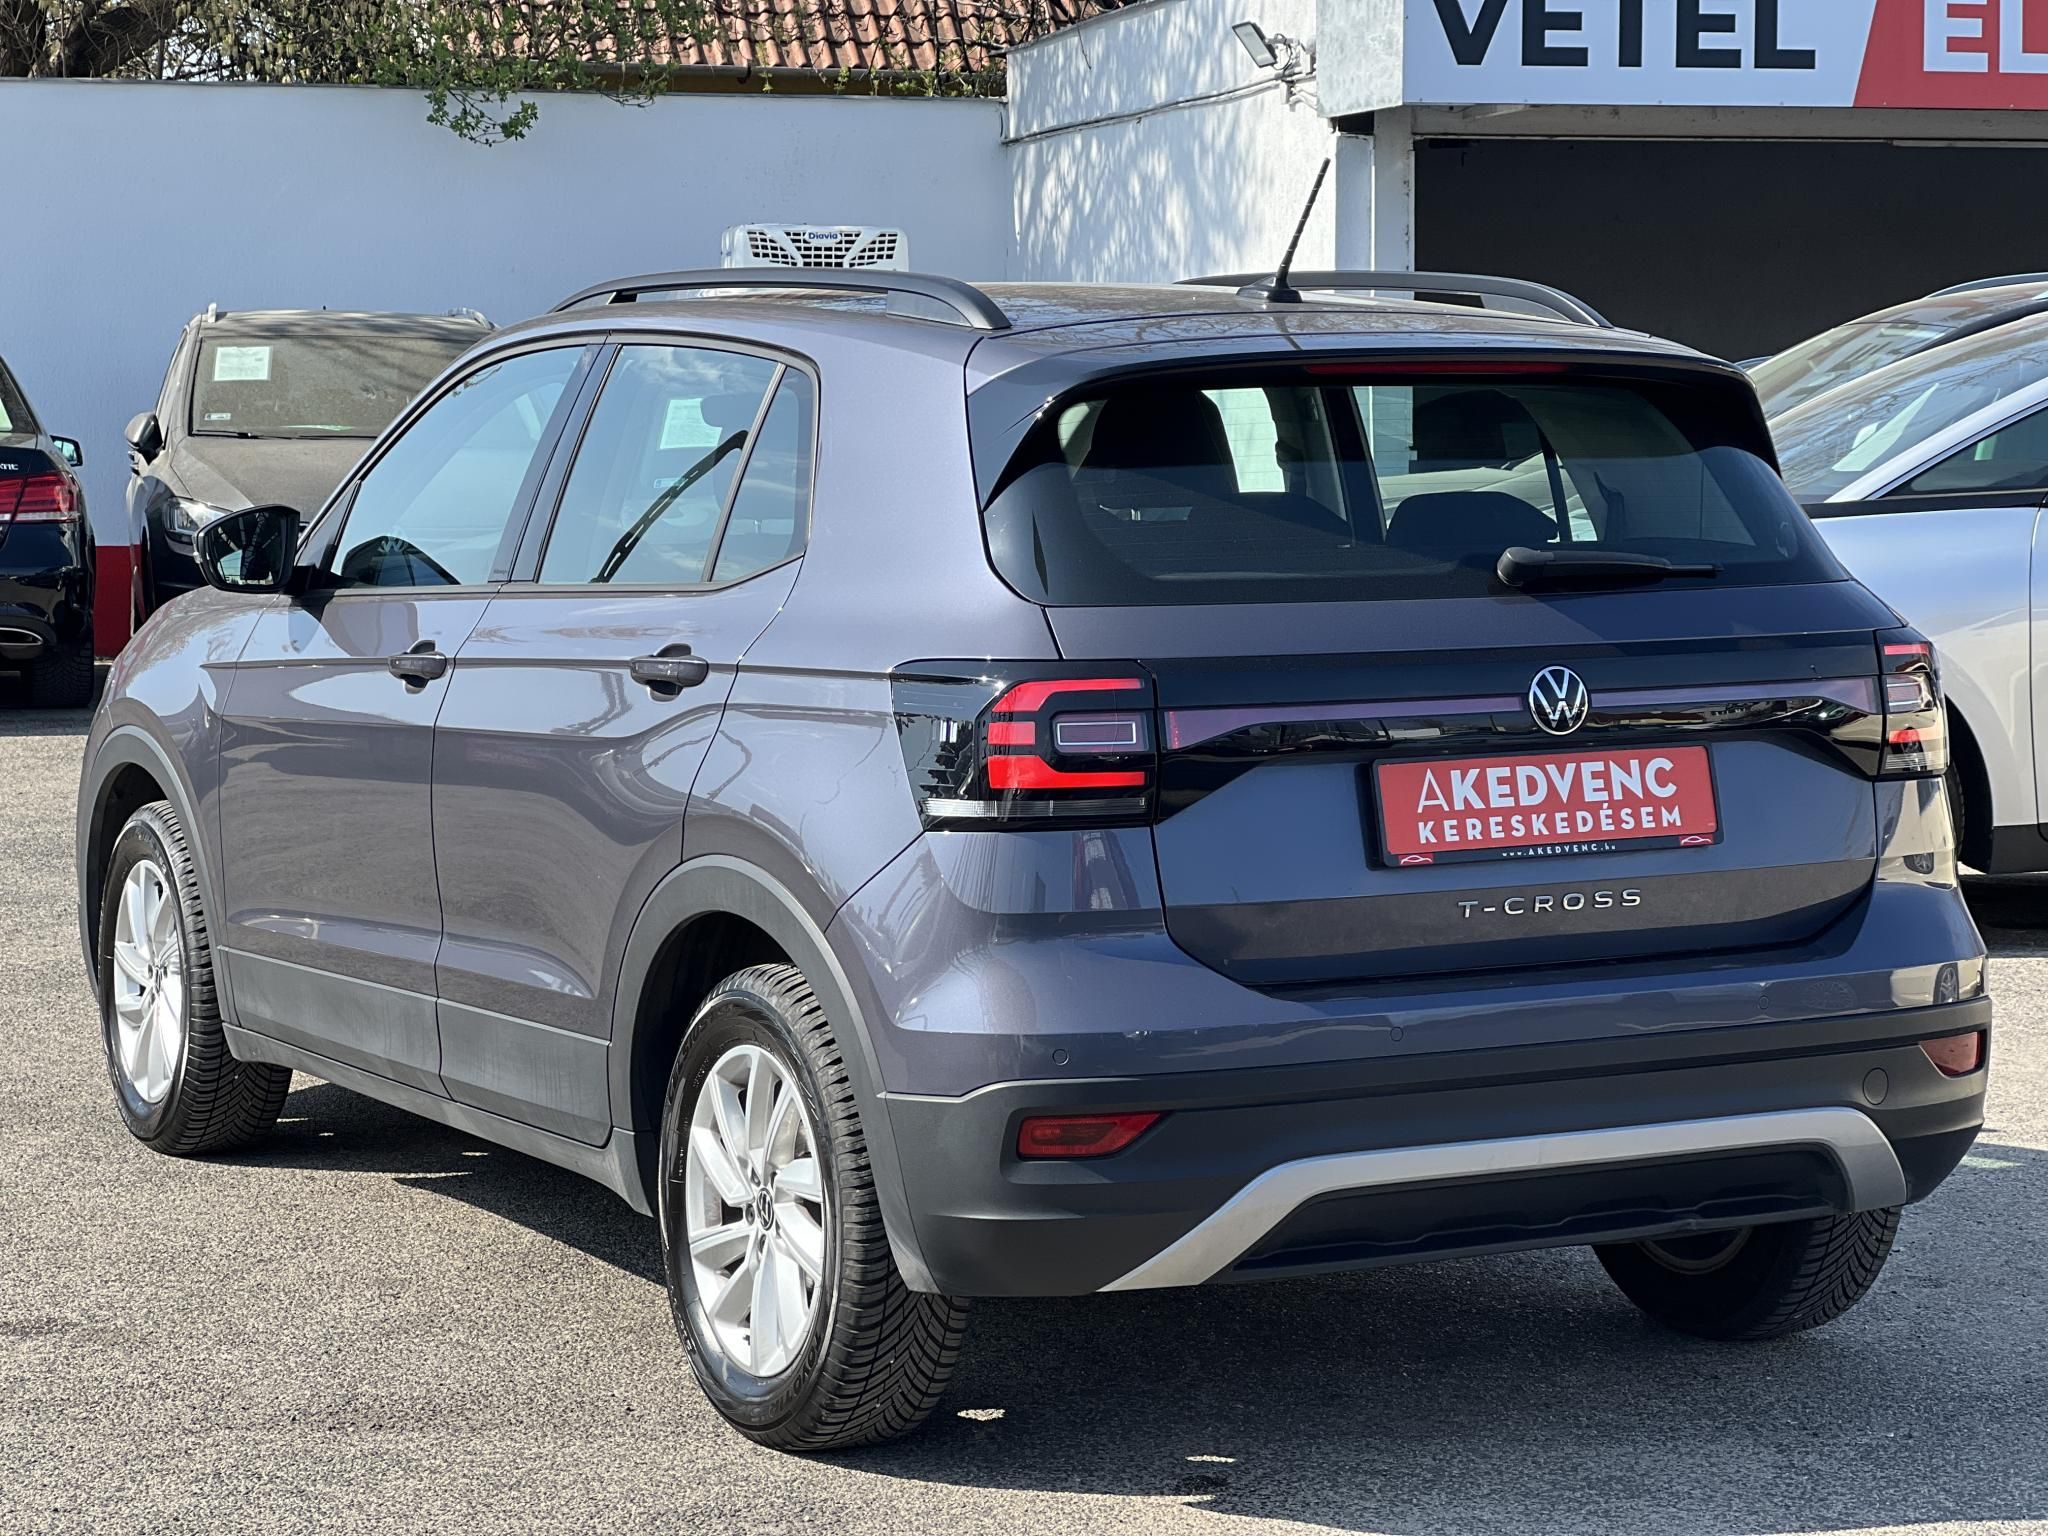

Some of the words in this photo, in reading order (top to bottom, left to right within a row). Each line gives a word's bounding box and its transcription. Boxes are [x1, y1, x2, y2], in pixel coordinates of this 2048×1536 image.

[808, 231, 839, 240] Diavia
[1417, 757, 1678, 814] AKEDVENC
[1418, 803, 1683, 845] KERESKEDÉSEM
[1457, 888, 1642, 919] T-CROSS
